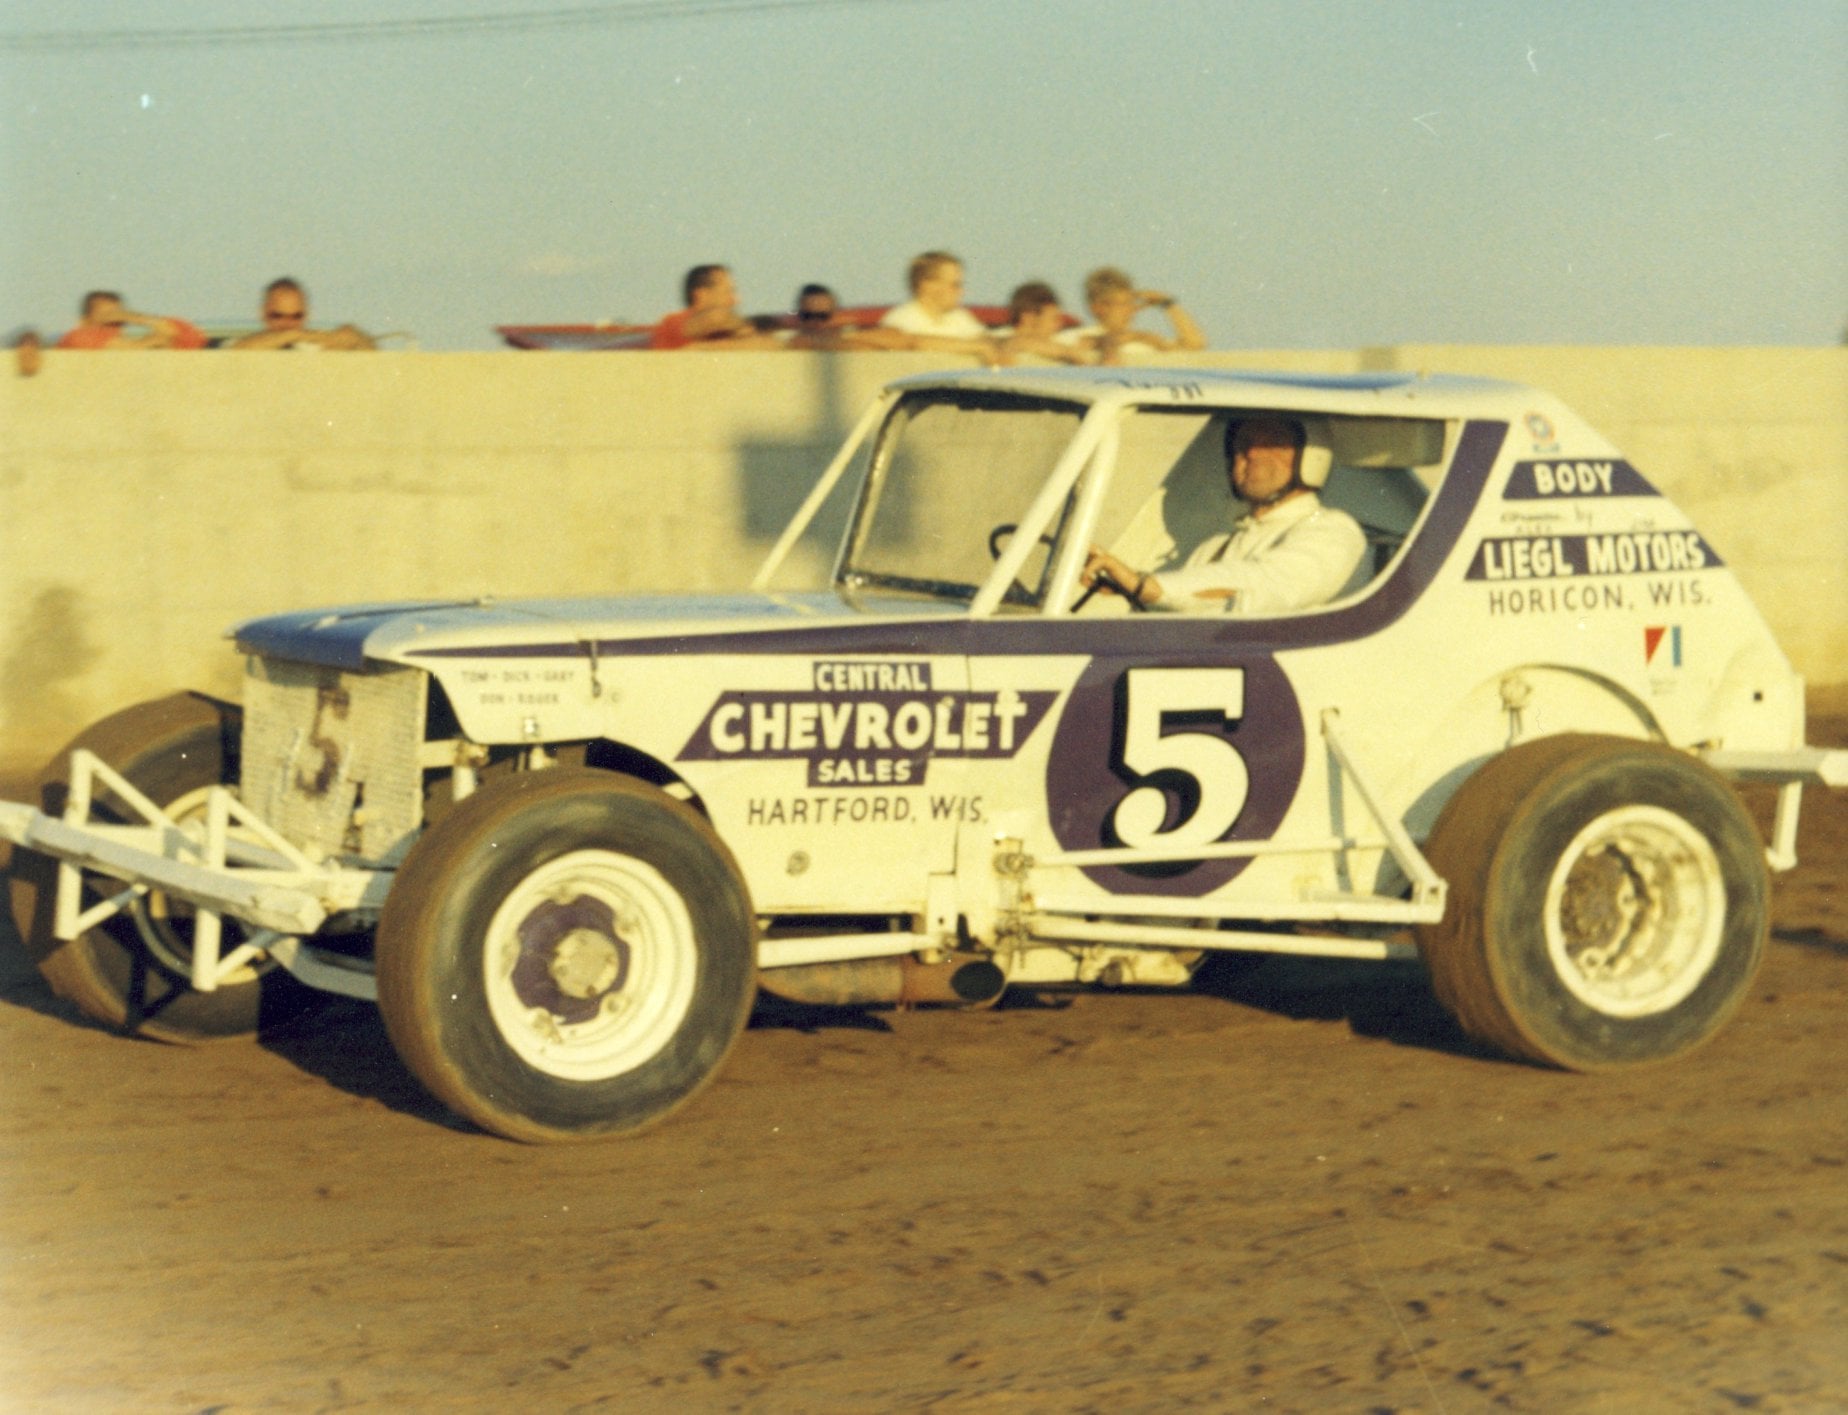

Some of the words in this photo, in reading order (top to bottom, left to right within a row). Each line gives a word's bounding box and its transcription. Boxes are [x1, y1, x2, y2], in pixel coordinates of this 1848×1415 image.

[1533, 462, 1613, 495] BODY
[1483, 537, 1574, 580] LIEGL
[1586, 531, 1706, 575] MOTORS
[1488, 584, 1635, 616] HORICON,
[1648, 580, 1712, 606] WIS.
[815, 663, 928, 692] CENTRAL
[709, 695, 1029, 753] CHEVROLET
[817, 759, 913, 783] SALES
[1108, 666, 1250, 862] 5
[748, 798, 917, 826] HARTFORD,
[930, 795, 990, 824] WIS.
